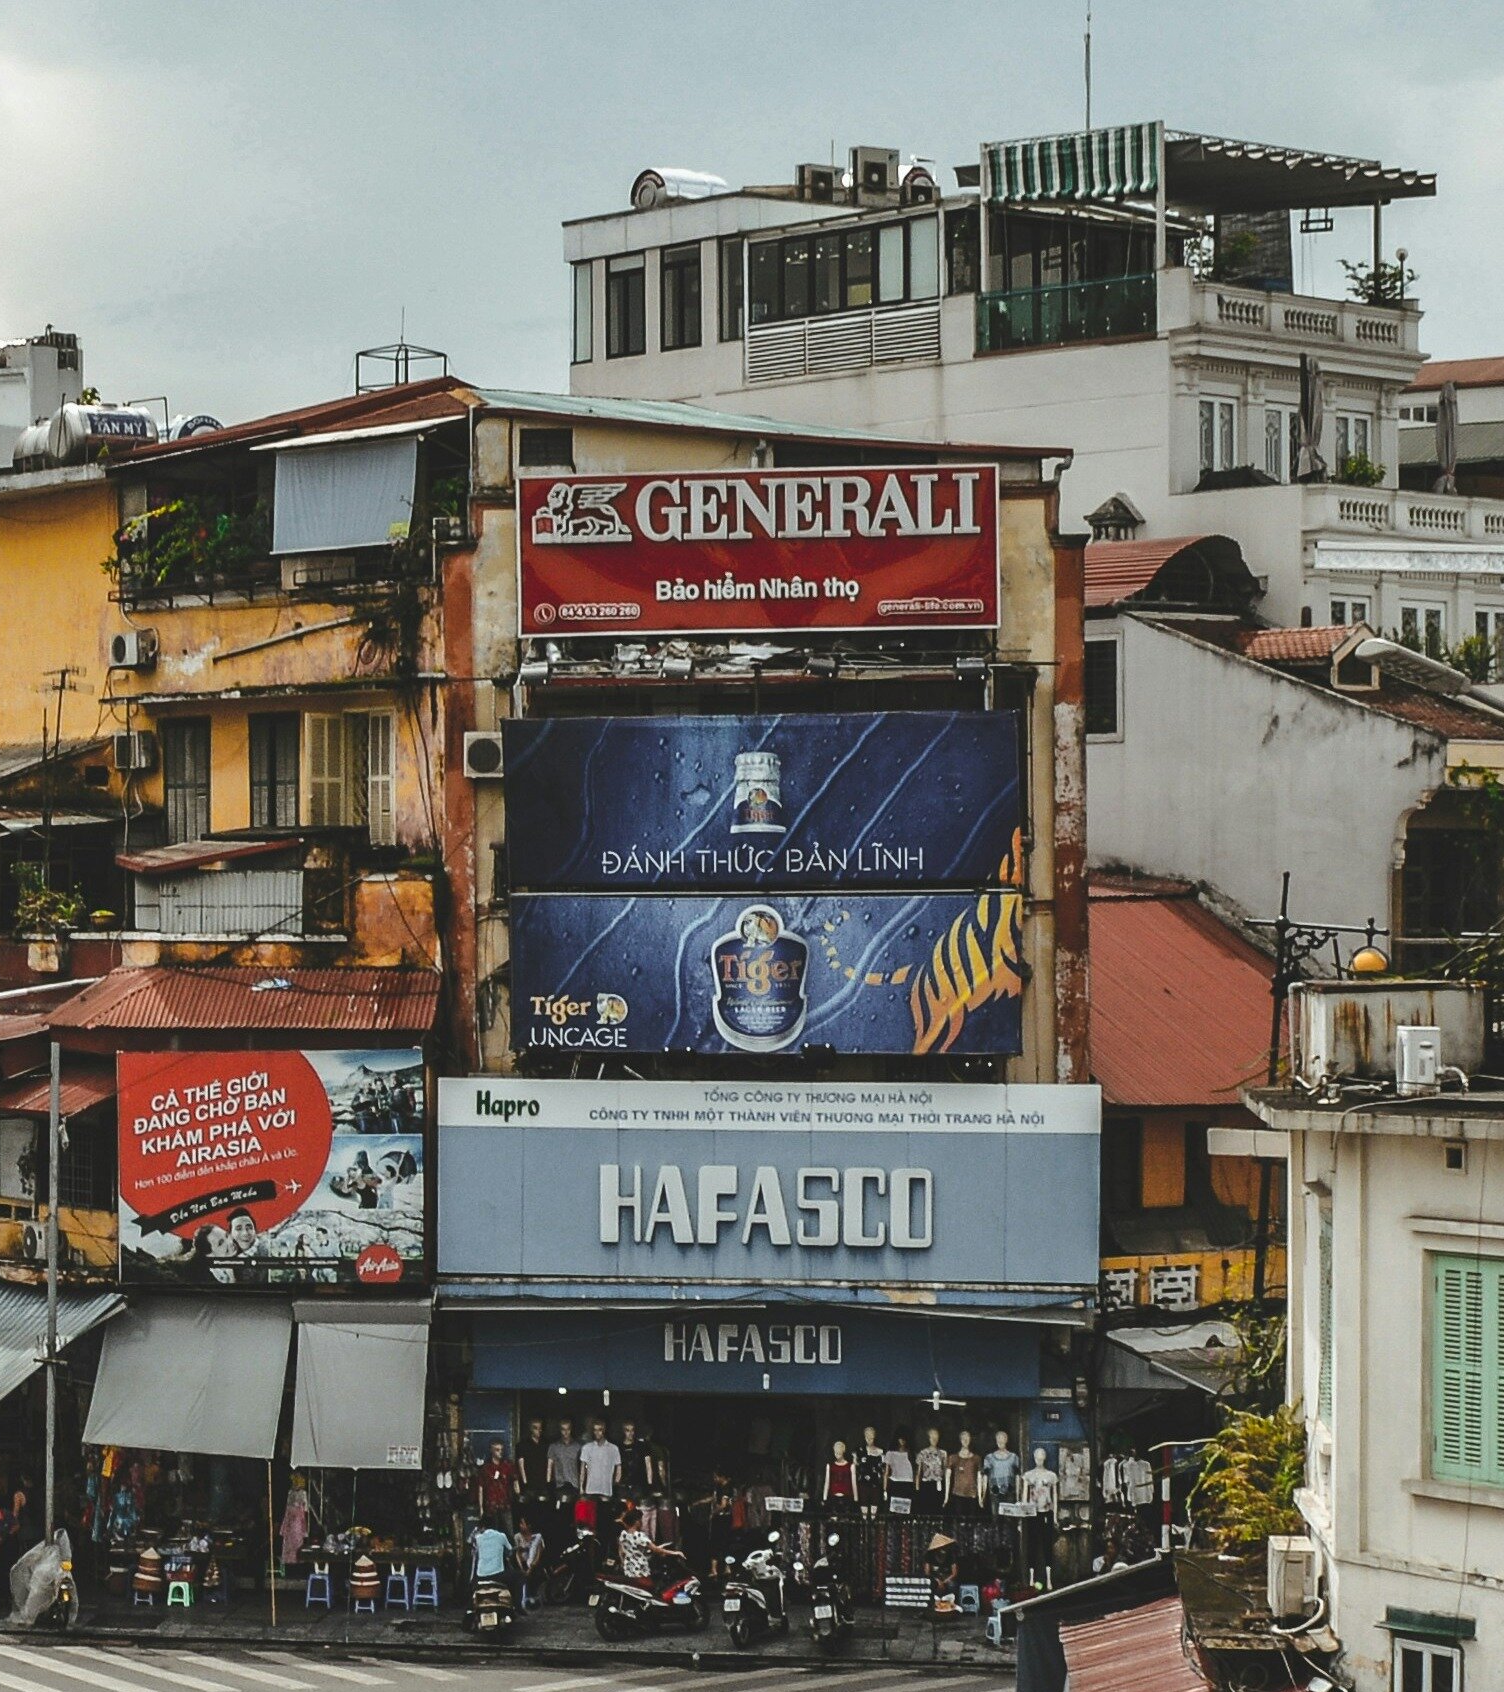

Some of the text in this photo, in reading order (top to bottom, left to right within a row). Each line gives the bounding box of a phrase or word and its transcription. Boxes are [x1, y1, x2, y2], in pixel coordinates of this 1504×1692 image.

[636, 470, 982, 542] GENERALI
[655, 572, 860, 604] Bảo hiểm Nhân thọ
[600, 836, 924, 876] ĐÁNH THỨC BẢN LĨNH
[719, 950, 803, 996] Tiger
[529, 994, 592, 1026] Tiger
[528, 1026, 628, 1048] UNCAGE
[151, 1070, 268, 1112] CẢ THẾ GIỚI
[475, 1090, 541, 1120] Hapro
[703, 1088, 740, 1103] TỔNG
[743, 1089, 784, 1102] CÔNG
[787, 1091, 802, 1102] TY
[133, 1088, 286, 1135] ĐANG CHỜ BẠN
[589, 1108, 629, 1122] CÔNG
[631, 1109, 649, 1121] TY
[651, 1109, 691, 1122] TNHH
[694, 1108, 725, 1124] MỘT
[728, 1107, 776, 1122] THÀNH
[779, 1108, 812, 1123] VIÊN
[815, 1111, 874, 1124] THƯƠNG
[878, 1112, 904, 1127] MẠI
[945, 1112, 993, 1125] TRANG
[996, 1109, 1016, 1125] HÀ
[1020, 1112, 1046, 1127] NỘI
[141, 1109, 296, 1156] KHÁM PHÁ VỚI
[176, 1136, 262, 1168] AIRASIA
[598, 1164, 934, 1250] HAFASCO
[664, 1321, 843, 1365] HAFASCO
